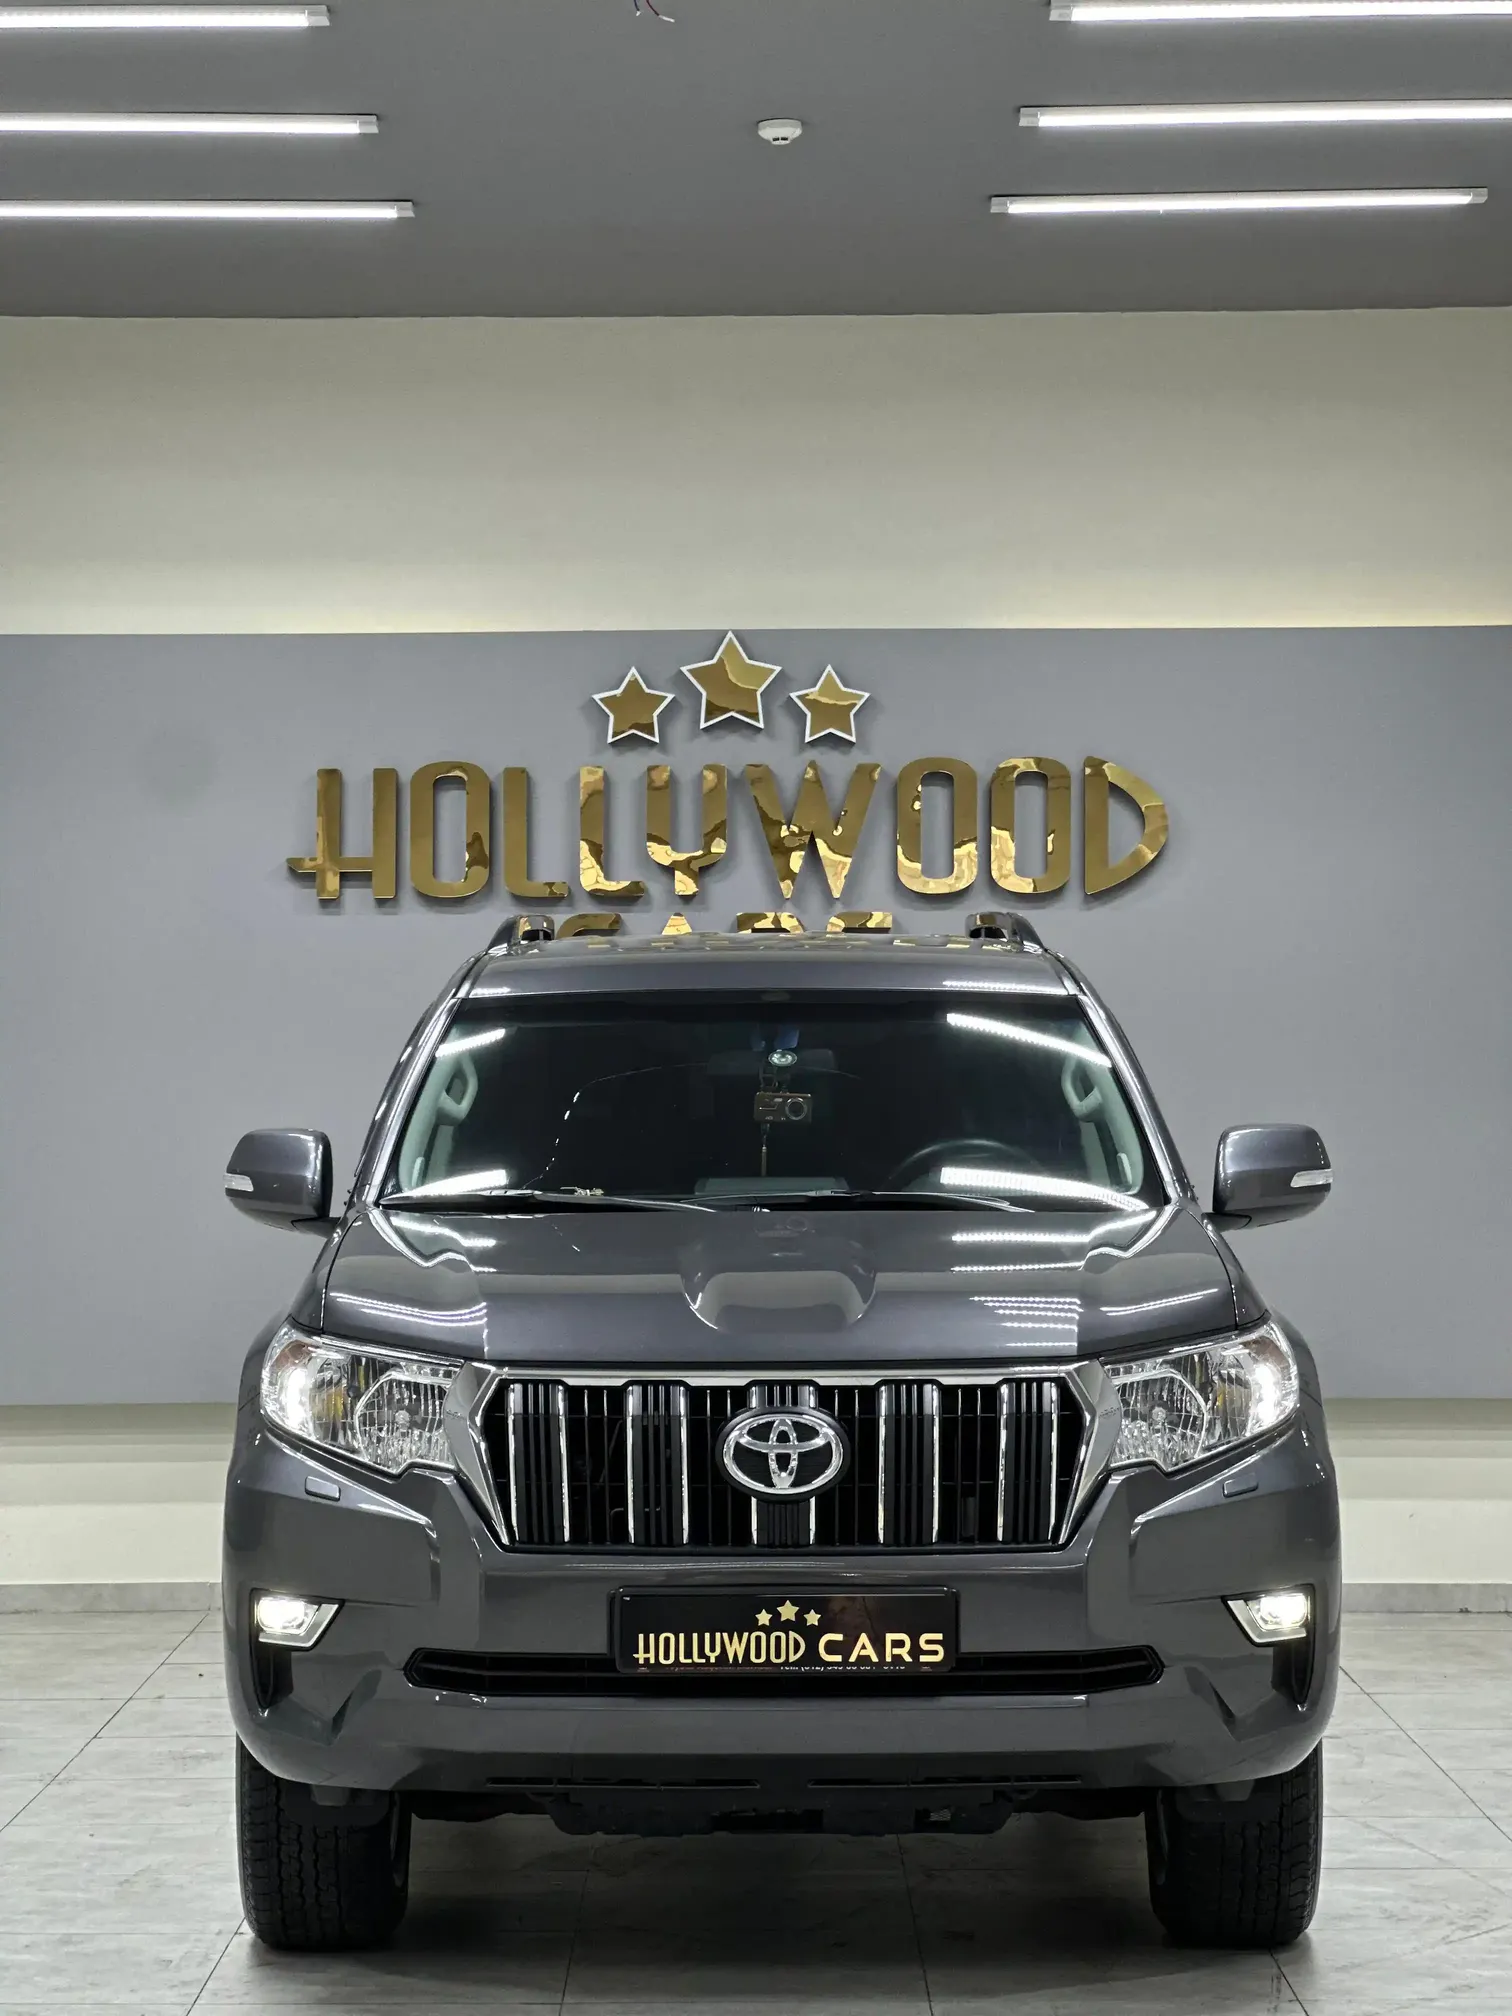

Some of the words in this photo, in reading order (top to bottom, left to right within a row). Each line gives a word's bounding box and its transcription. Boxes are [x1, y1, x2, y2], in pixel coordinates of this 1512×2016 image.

[286, 756, 1169, 899] HOLLYWOOD
[632, 1630, 806, 1665] HOLLYWOOD
[818, 1632, 945, 1663] CARS
